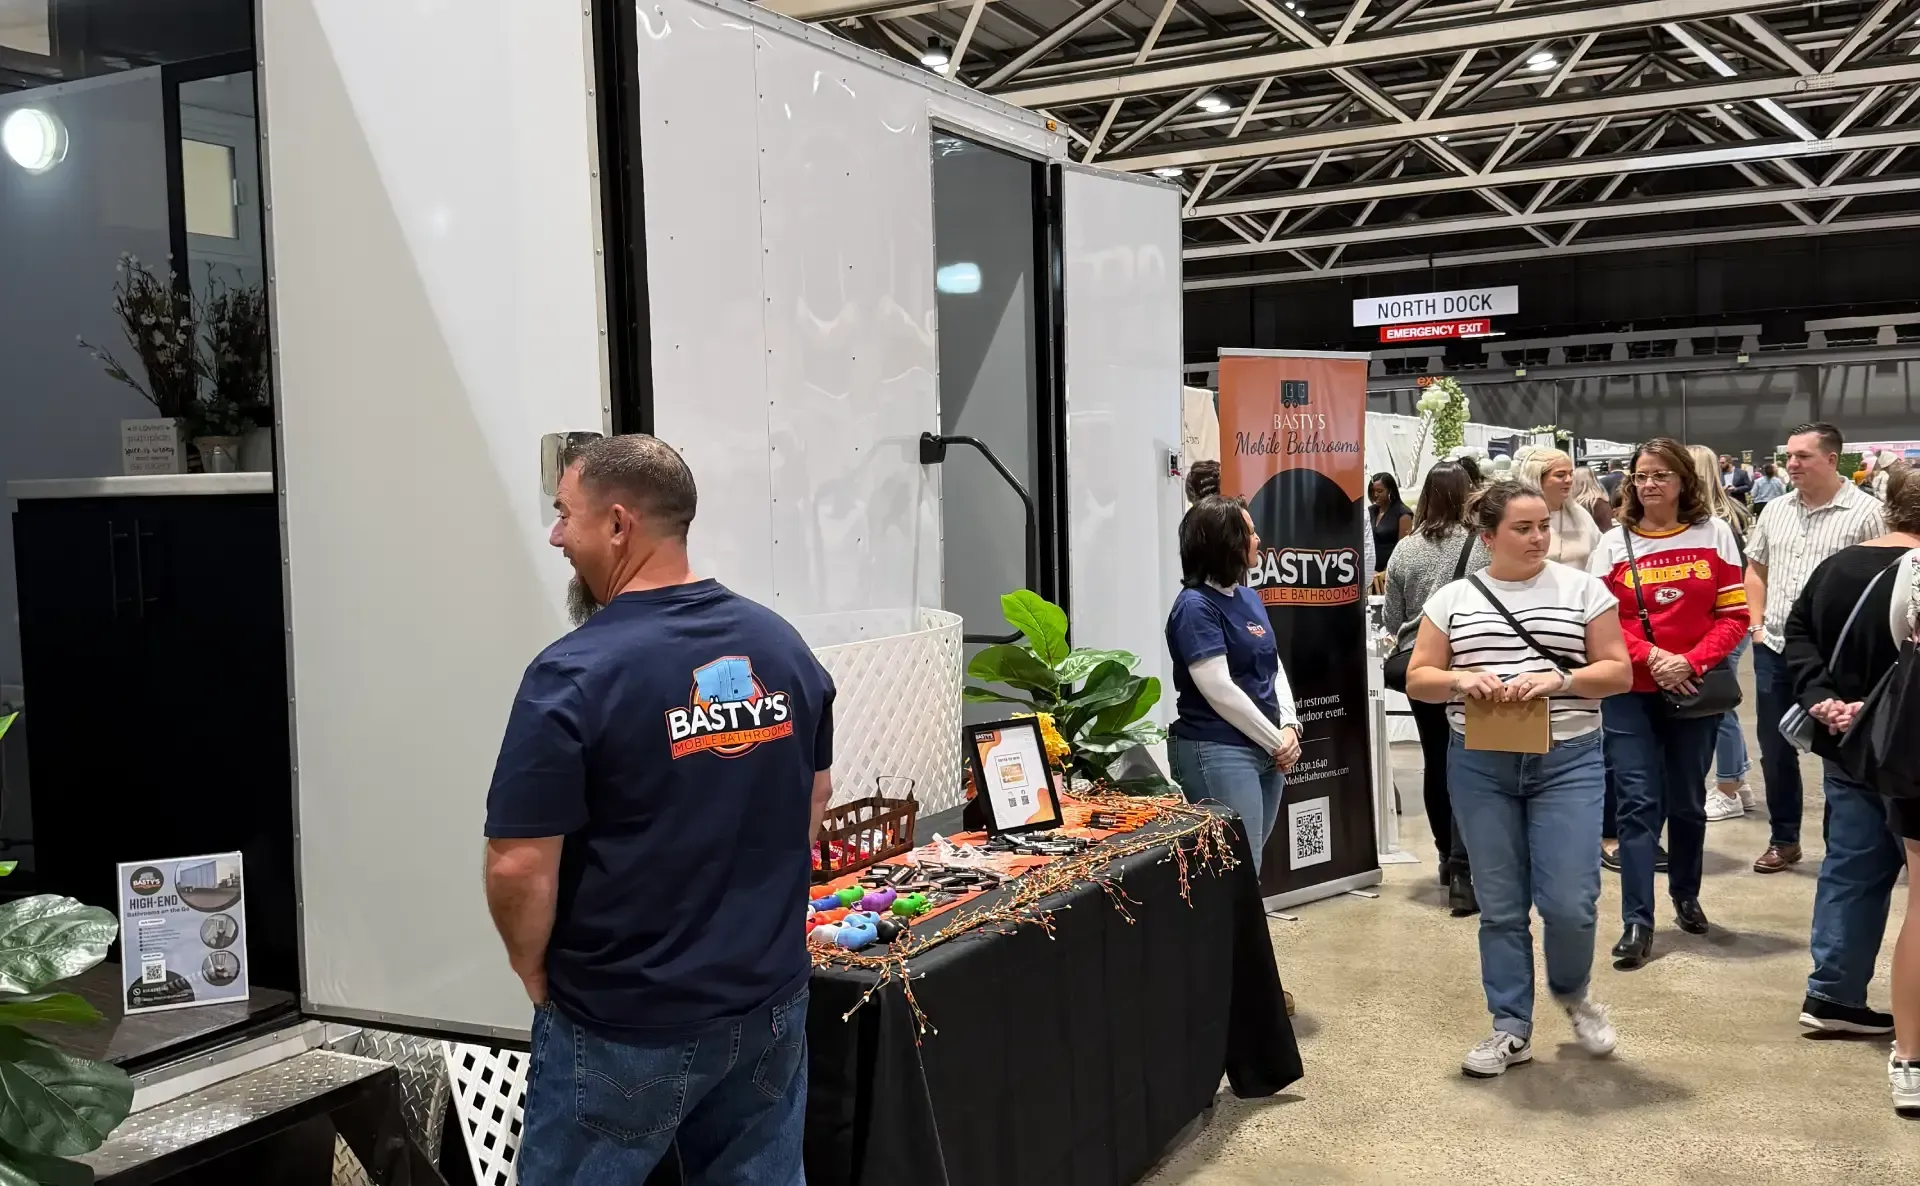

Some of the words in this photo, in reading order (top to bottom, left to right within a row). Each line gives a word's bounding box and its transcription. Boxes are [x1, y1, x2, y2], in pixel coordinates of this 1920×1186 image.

[1378, 299, 1436, 319] NORTH
[1443, 293, 1493, 314] DOCK
[1386, 324, 1454, 340] EMERGENCY
[1458, 322, 1483, 334] EXIT
[1273, 413, 1326, 430] BASTY'S
[1234, 431, 1281, 457] Mobile
[1286, 431, 1360, 455] Bathrooms
[1246, 551, 1354, 588] BASTY'S
[1257, 588, 1288, 601] OBILE
[1291, 586, 1357, 601] BATHROOMS
[1304, 694, 1340, 707] restrooms
[669, 694, 788, 741] BASTY'S
[1297, 710, 1323, 722] utdoor
[1325, 707, 1347, 719] event.
[674, 734, 718, 754] MOBILE
[721, 722, 792, 744] BATHROOMS
[130, 895, 178, 910] HIGH-END
